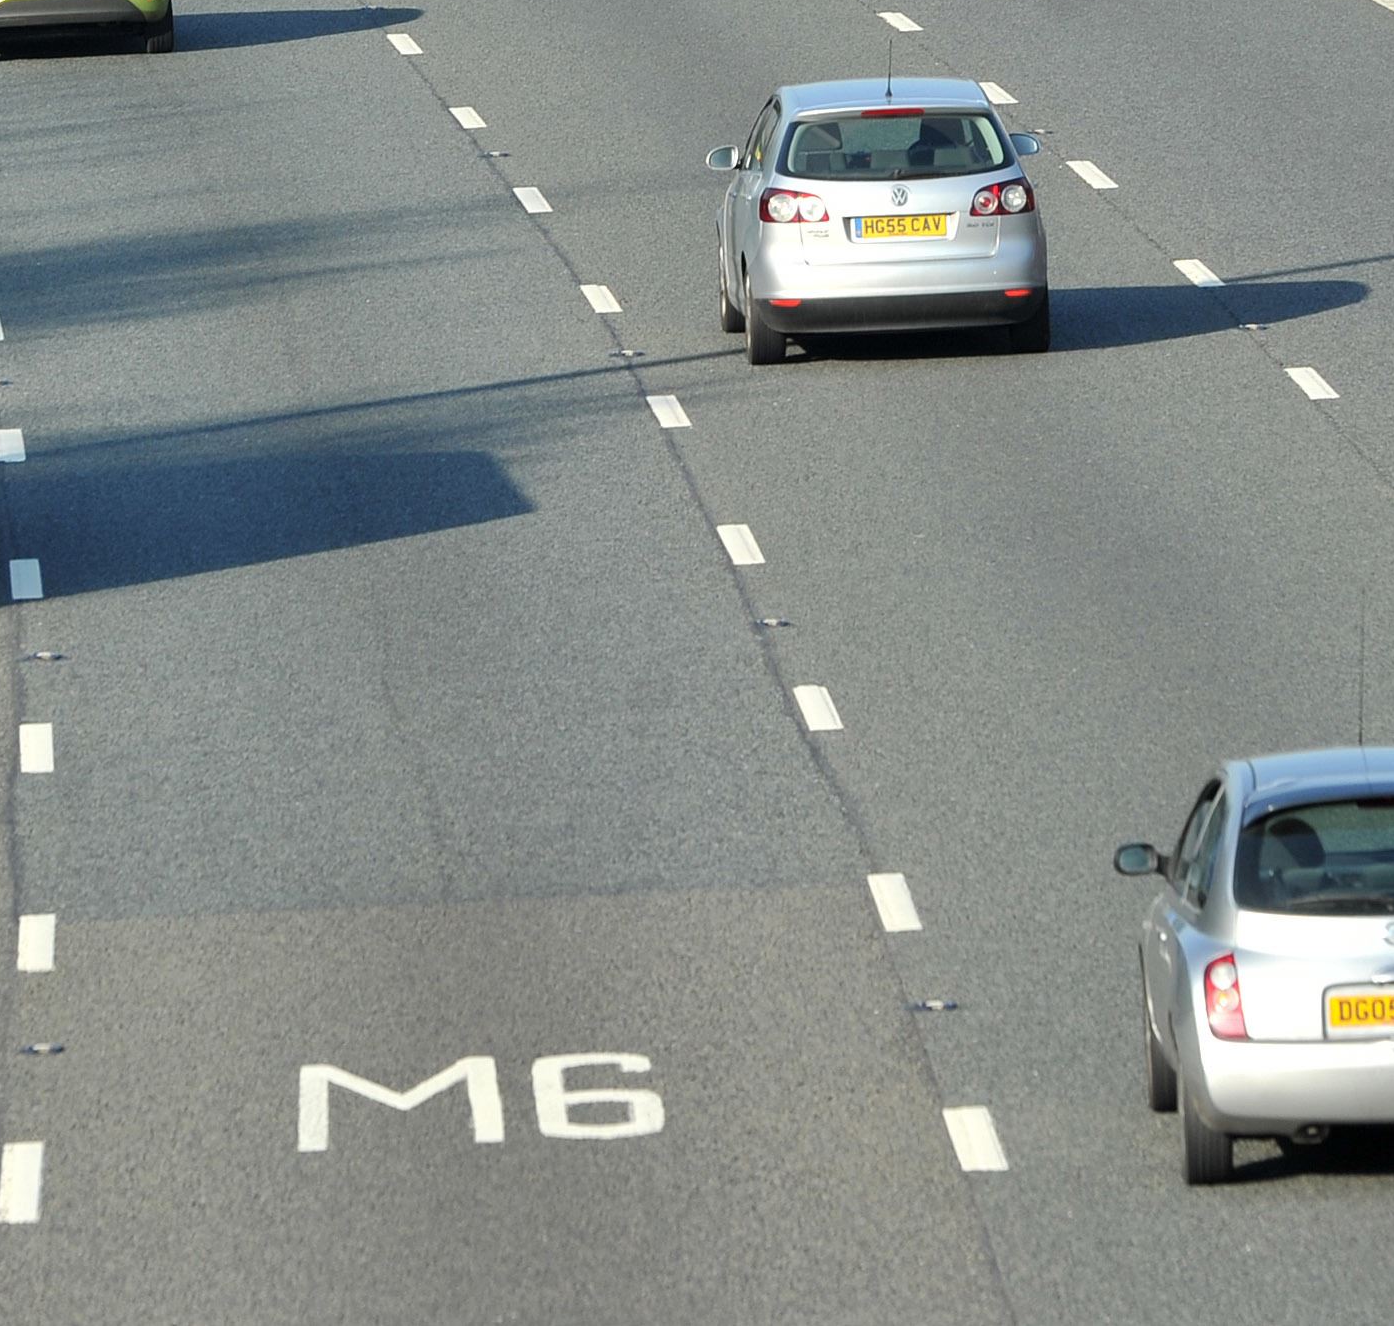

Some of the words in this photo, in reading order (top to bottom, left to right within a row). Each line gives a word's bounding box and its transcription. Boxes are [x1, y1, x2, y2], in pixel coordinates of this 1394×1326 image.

[864, 219, 906, 234] HG55
[911, 217, 942, 232] CAV
[296, 1051, 666, 1153] M6
